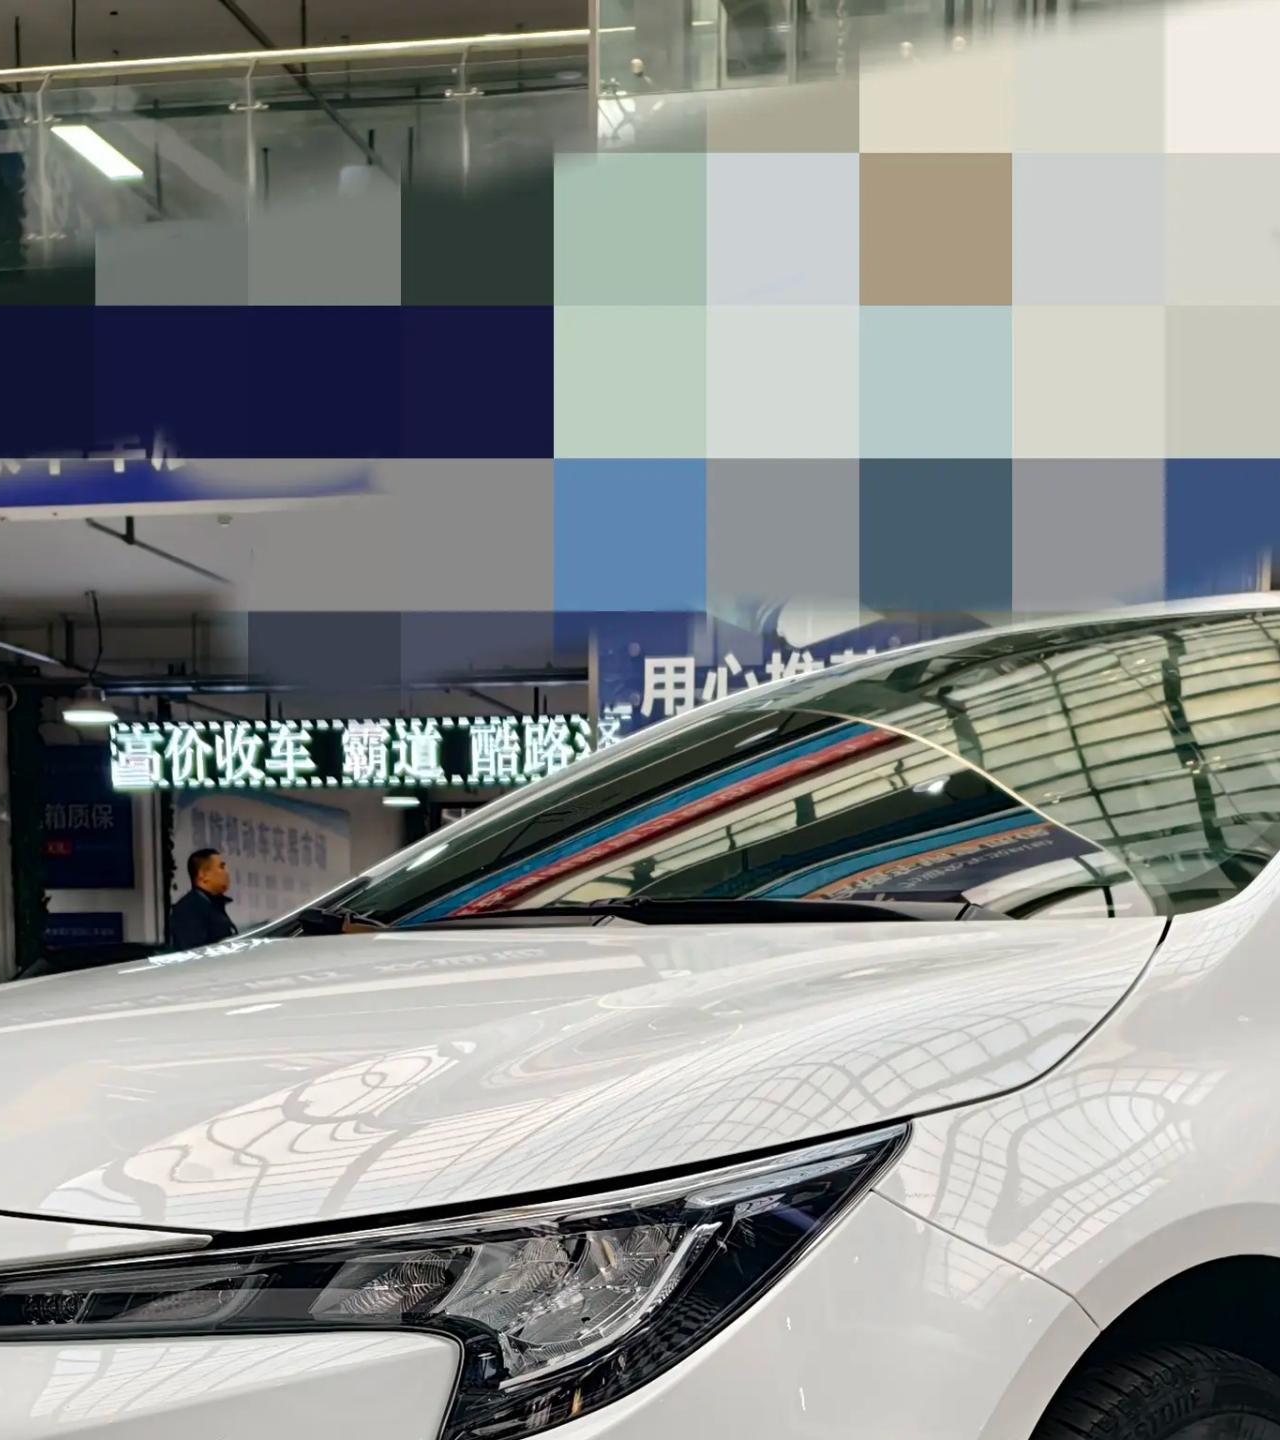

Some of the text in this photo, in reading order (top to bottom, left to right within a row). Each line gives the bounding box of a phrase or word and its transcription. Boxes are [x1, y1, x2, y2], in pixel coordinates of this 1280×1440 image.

[342, 718, 444, 781] 霸道
[37, 802, 115, 831] 箱质保
